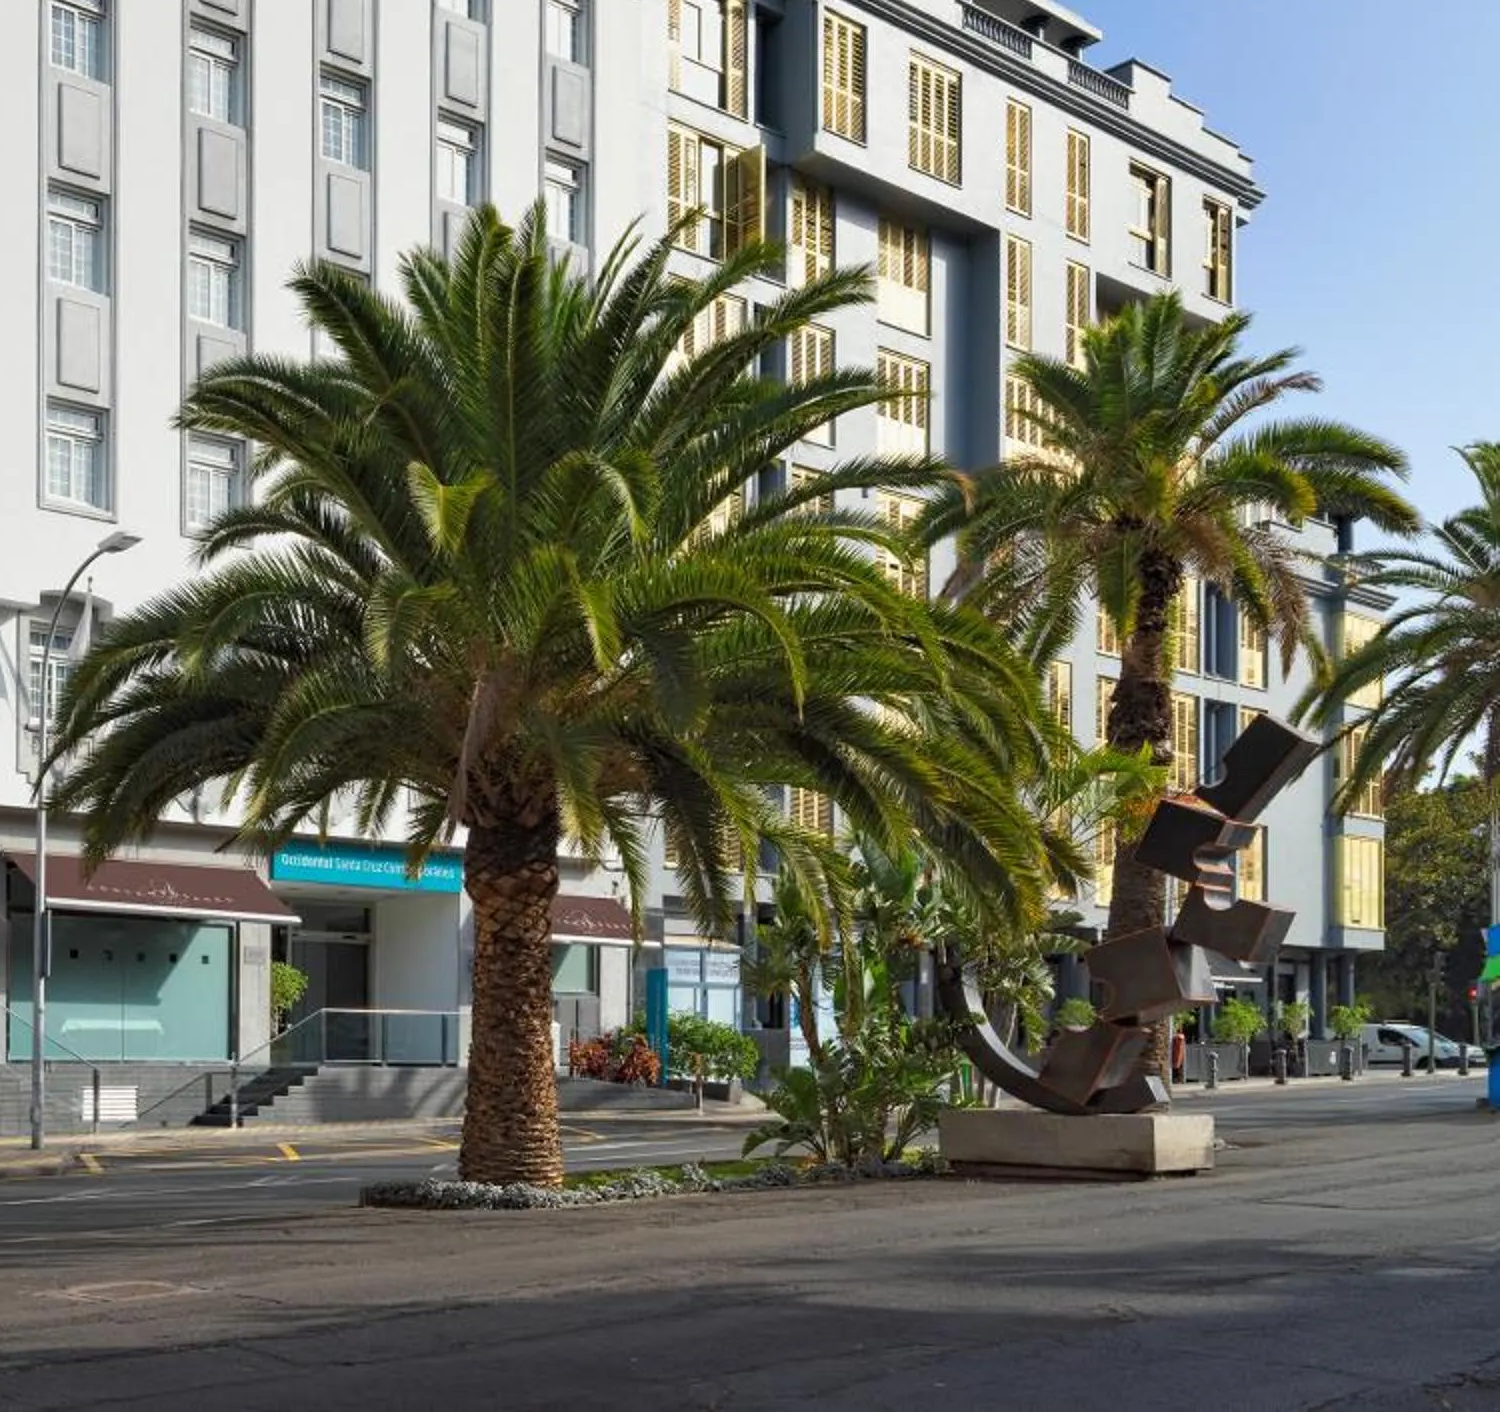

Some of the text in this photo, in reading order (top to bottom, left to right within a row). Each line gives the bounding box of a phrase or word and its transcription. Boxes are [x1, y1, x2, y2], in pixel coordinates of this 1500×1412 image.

[281, 853, 333, 870] Occidental
[335, 857, 361, 872] Santa
[363, 859, 384, 873] Cruz
